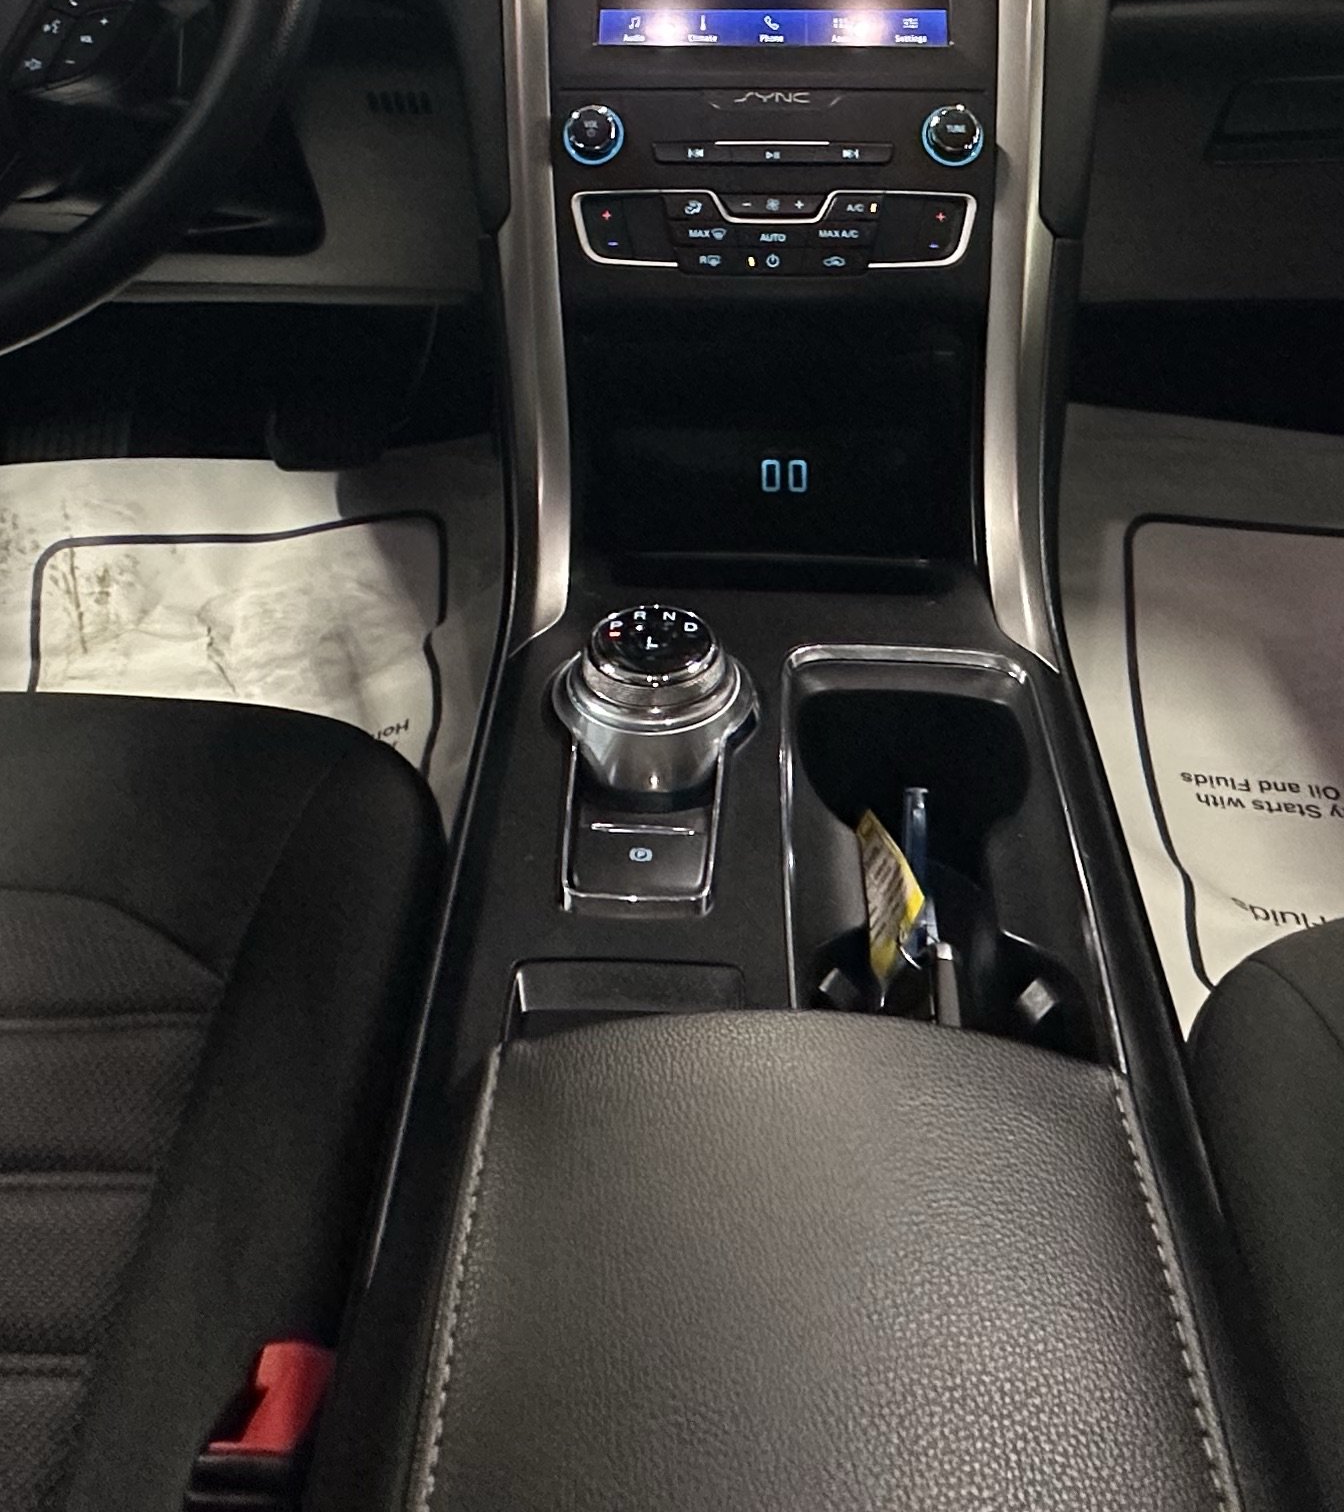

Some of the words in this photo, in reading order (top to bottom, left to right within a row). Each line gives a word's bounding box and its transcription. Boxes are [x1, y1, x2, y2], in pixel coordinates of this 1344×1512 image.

[734, 91, 810, 104] SYNC
[846, 204, 864, 213] A/C
[688, 229, 710, 238] MAX
[760, 234, 786, 243] AUTO
[818, 230, 840, 239] MAX
[841, 230, 859, 239] A/C
[633, 610, 646, 620] R
[662, 611, 676, 621] N
[609, 620, 623, 630] P
[683, 622, 698, 632] D
[1179, 770, 1250, 793] Fluids
[1258, 778, 1301, 795] and
[1308, 784, 1340, 801] Oil
[1195, 791, 1246, 811] with
[1251, 799, 1323, 820] Starts
